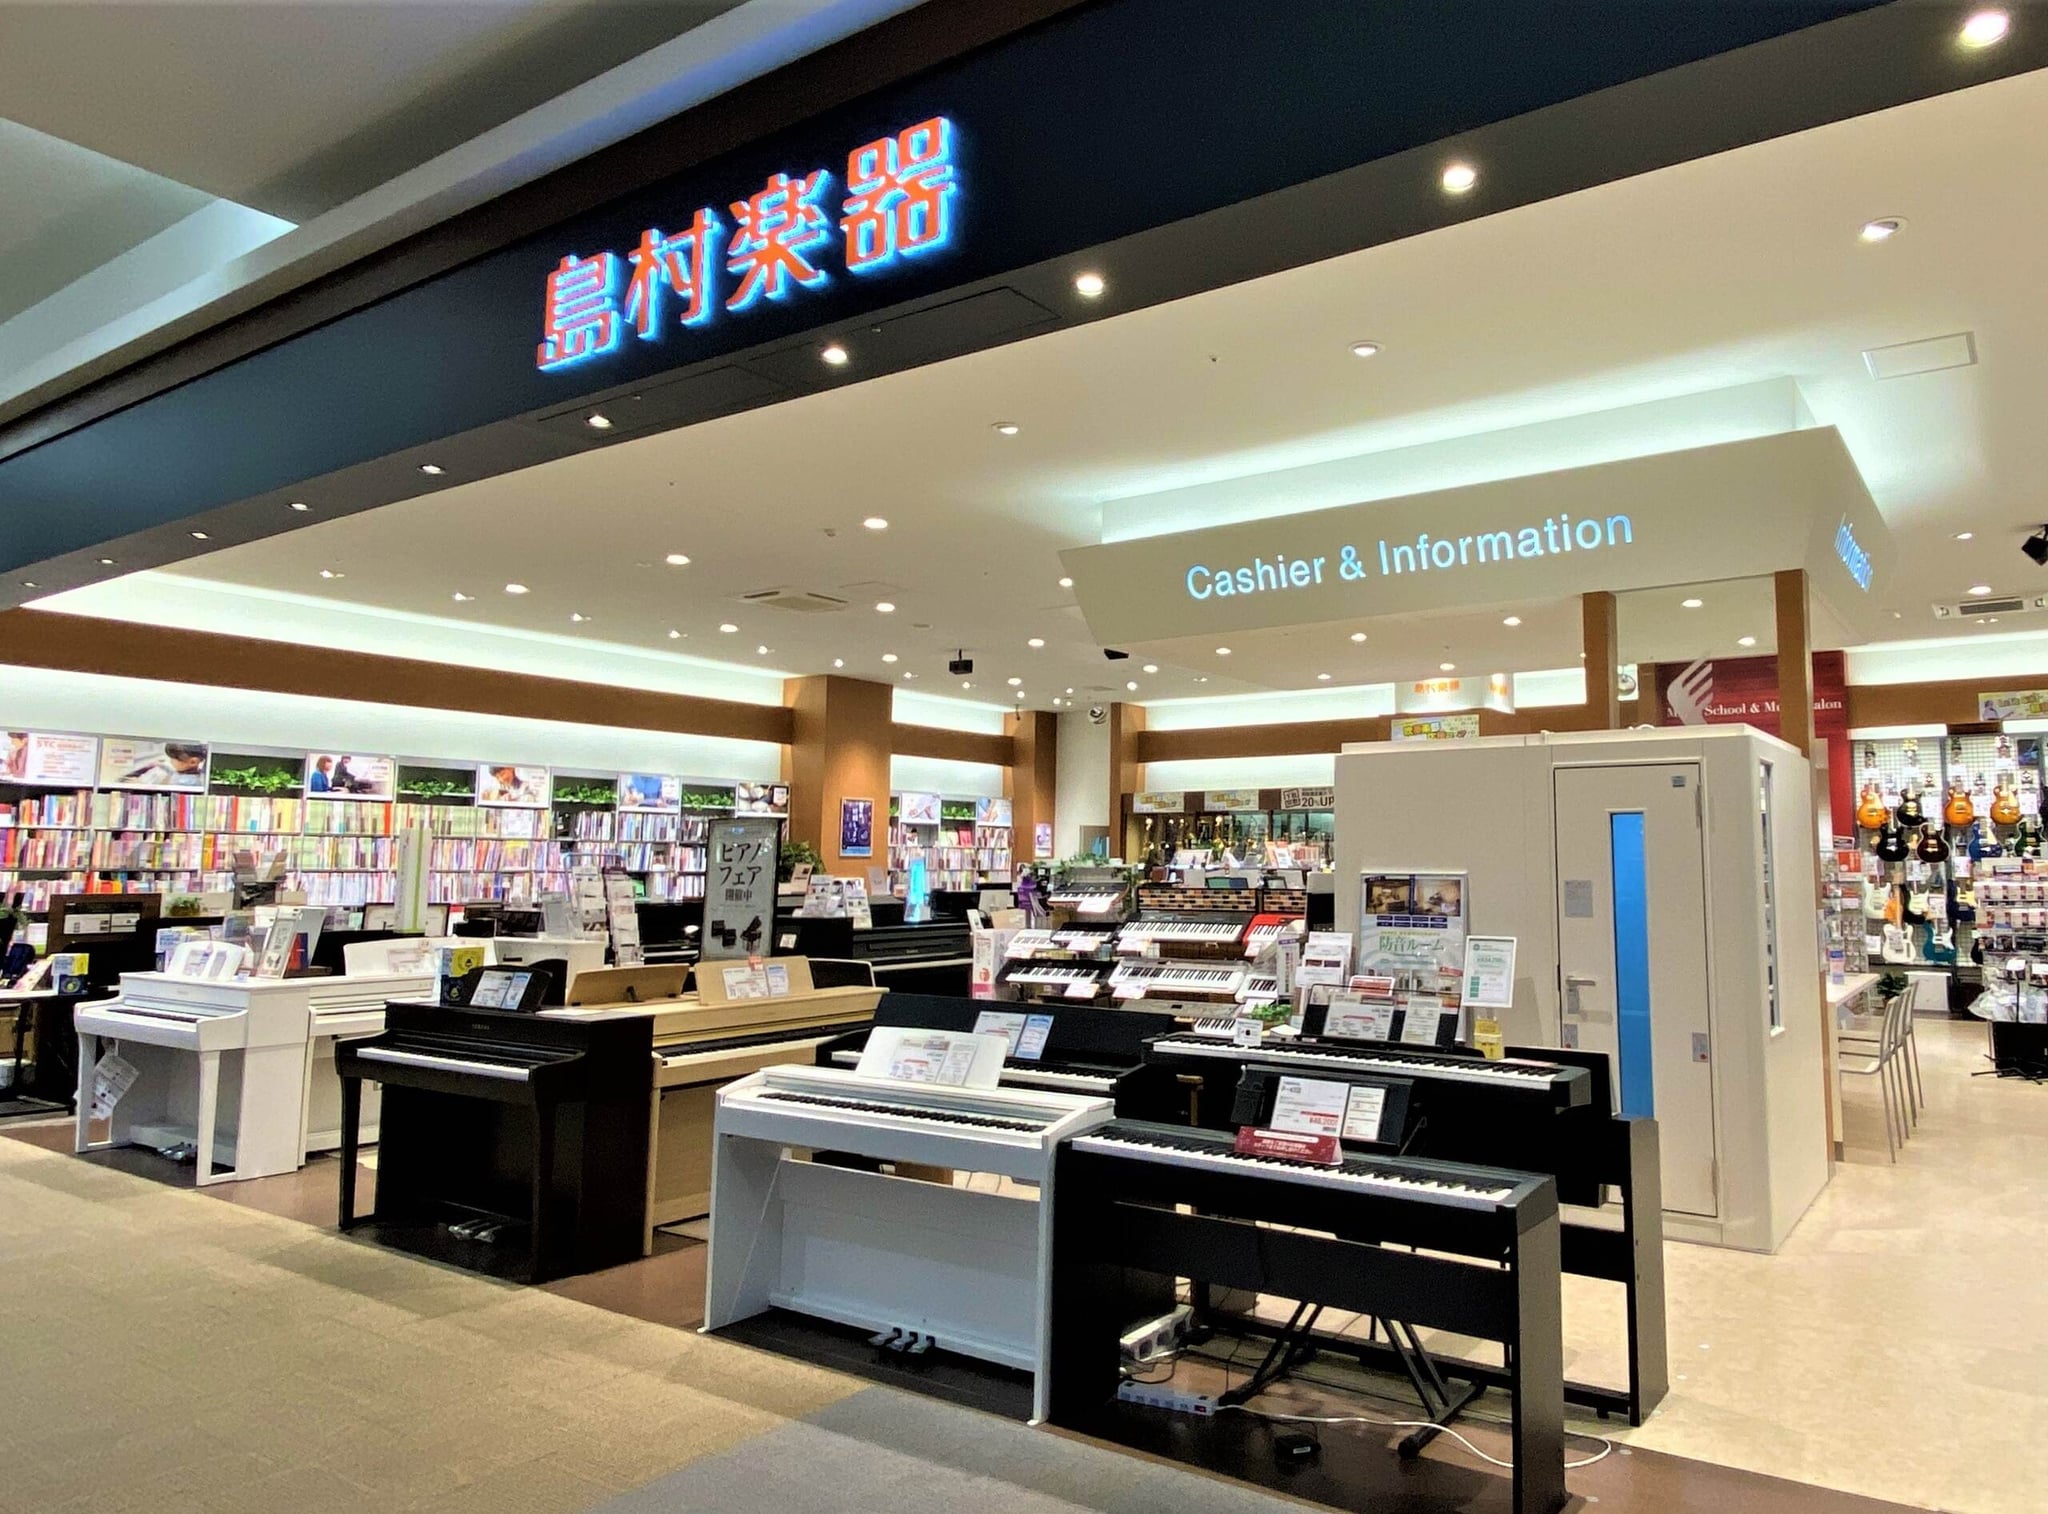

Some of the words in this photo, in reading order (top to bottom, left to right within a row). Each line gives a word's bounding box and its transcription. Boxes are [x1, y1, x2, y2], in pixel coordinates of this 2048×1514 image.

[536, 115, 957, 371] 島村楽器
[1186, 554, 1327, 600] Cashier
[1339, 545, 1367, 581] &
[1378, 513, 1633, 576] Information
[1704, 702, 1746, 716] School
[1750, 702, 1760, 713] &
[1812, 698, 1842, 710] alon
[720, 866, 762, 886] フェア
[1379, 935, 1444, 952] 防音ルーム
